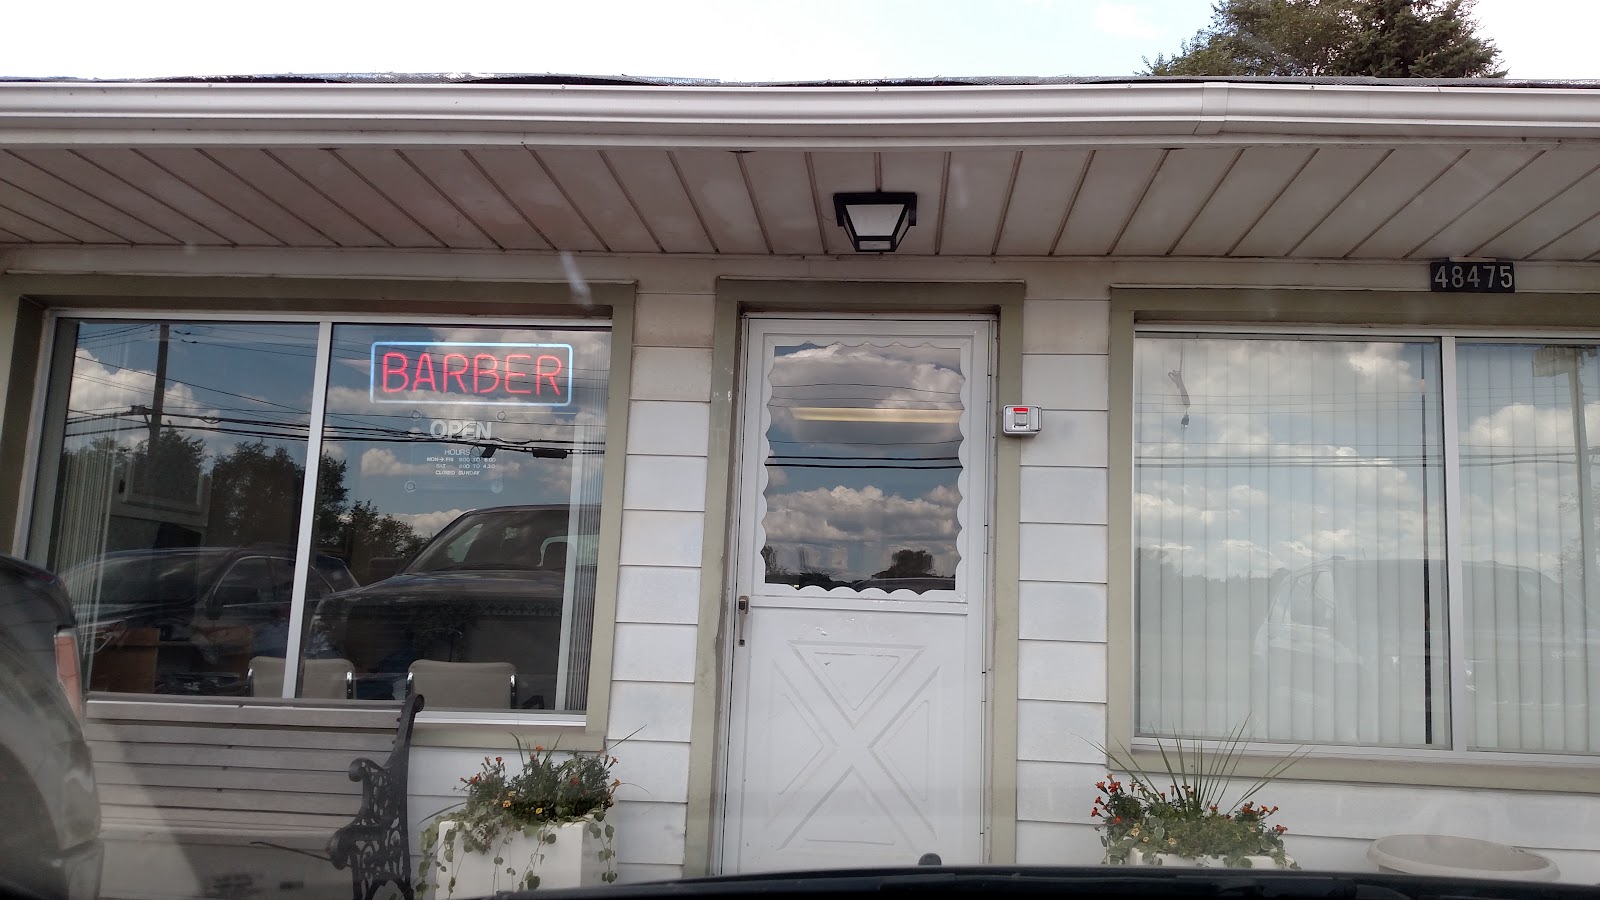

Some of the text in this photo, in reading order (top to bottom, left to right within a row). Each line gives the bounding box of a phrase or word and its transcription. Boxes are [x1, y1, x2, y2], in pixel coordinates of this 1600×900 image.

[1434, 265, 1513, 288] 48475
[381, 350, 563, 396] BARBER
[429, 419, 492, 440] OPEN
[444, 448, 470, 456] HOURS
